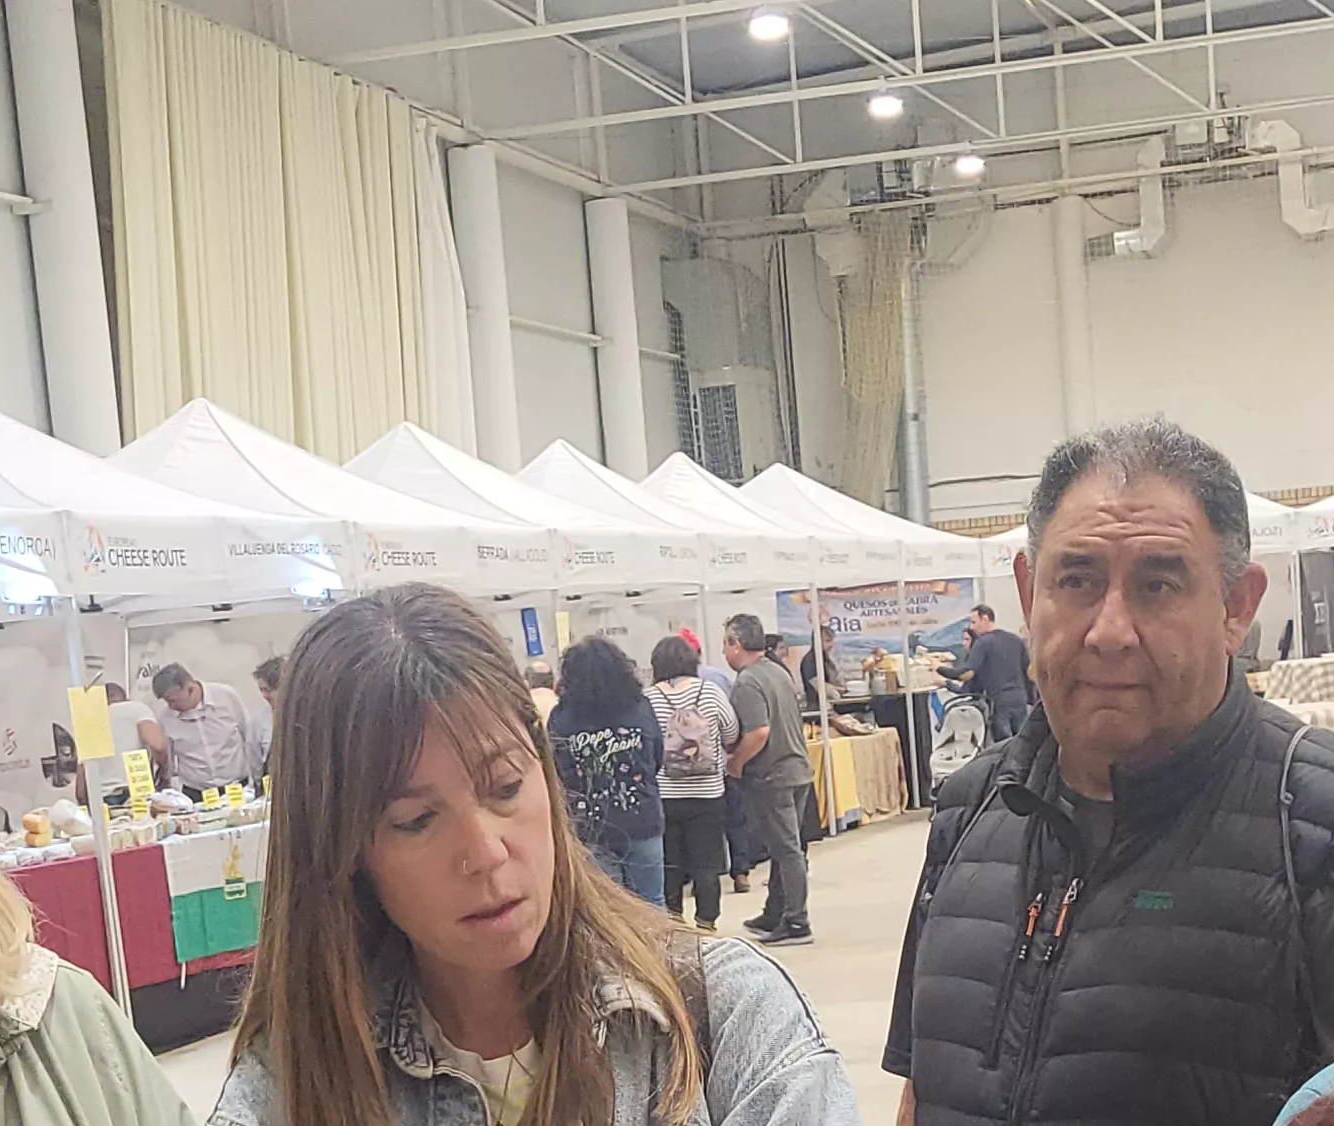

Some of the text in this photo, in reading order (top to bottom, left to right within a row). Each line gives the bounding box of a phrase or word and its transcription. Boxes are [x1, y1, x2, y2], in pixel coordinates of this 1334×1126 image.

[108, 548, 187, 567] CHEESE ROUTE
[381, 551, 437, 567] CHEESE ROUTE
[860, 606, 929, 618] ARTESAALES
[576, 727, 613, 752] Pepe
[599, 734, 642, 763] Jeans
